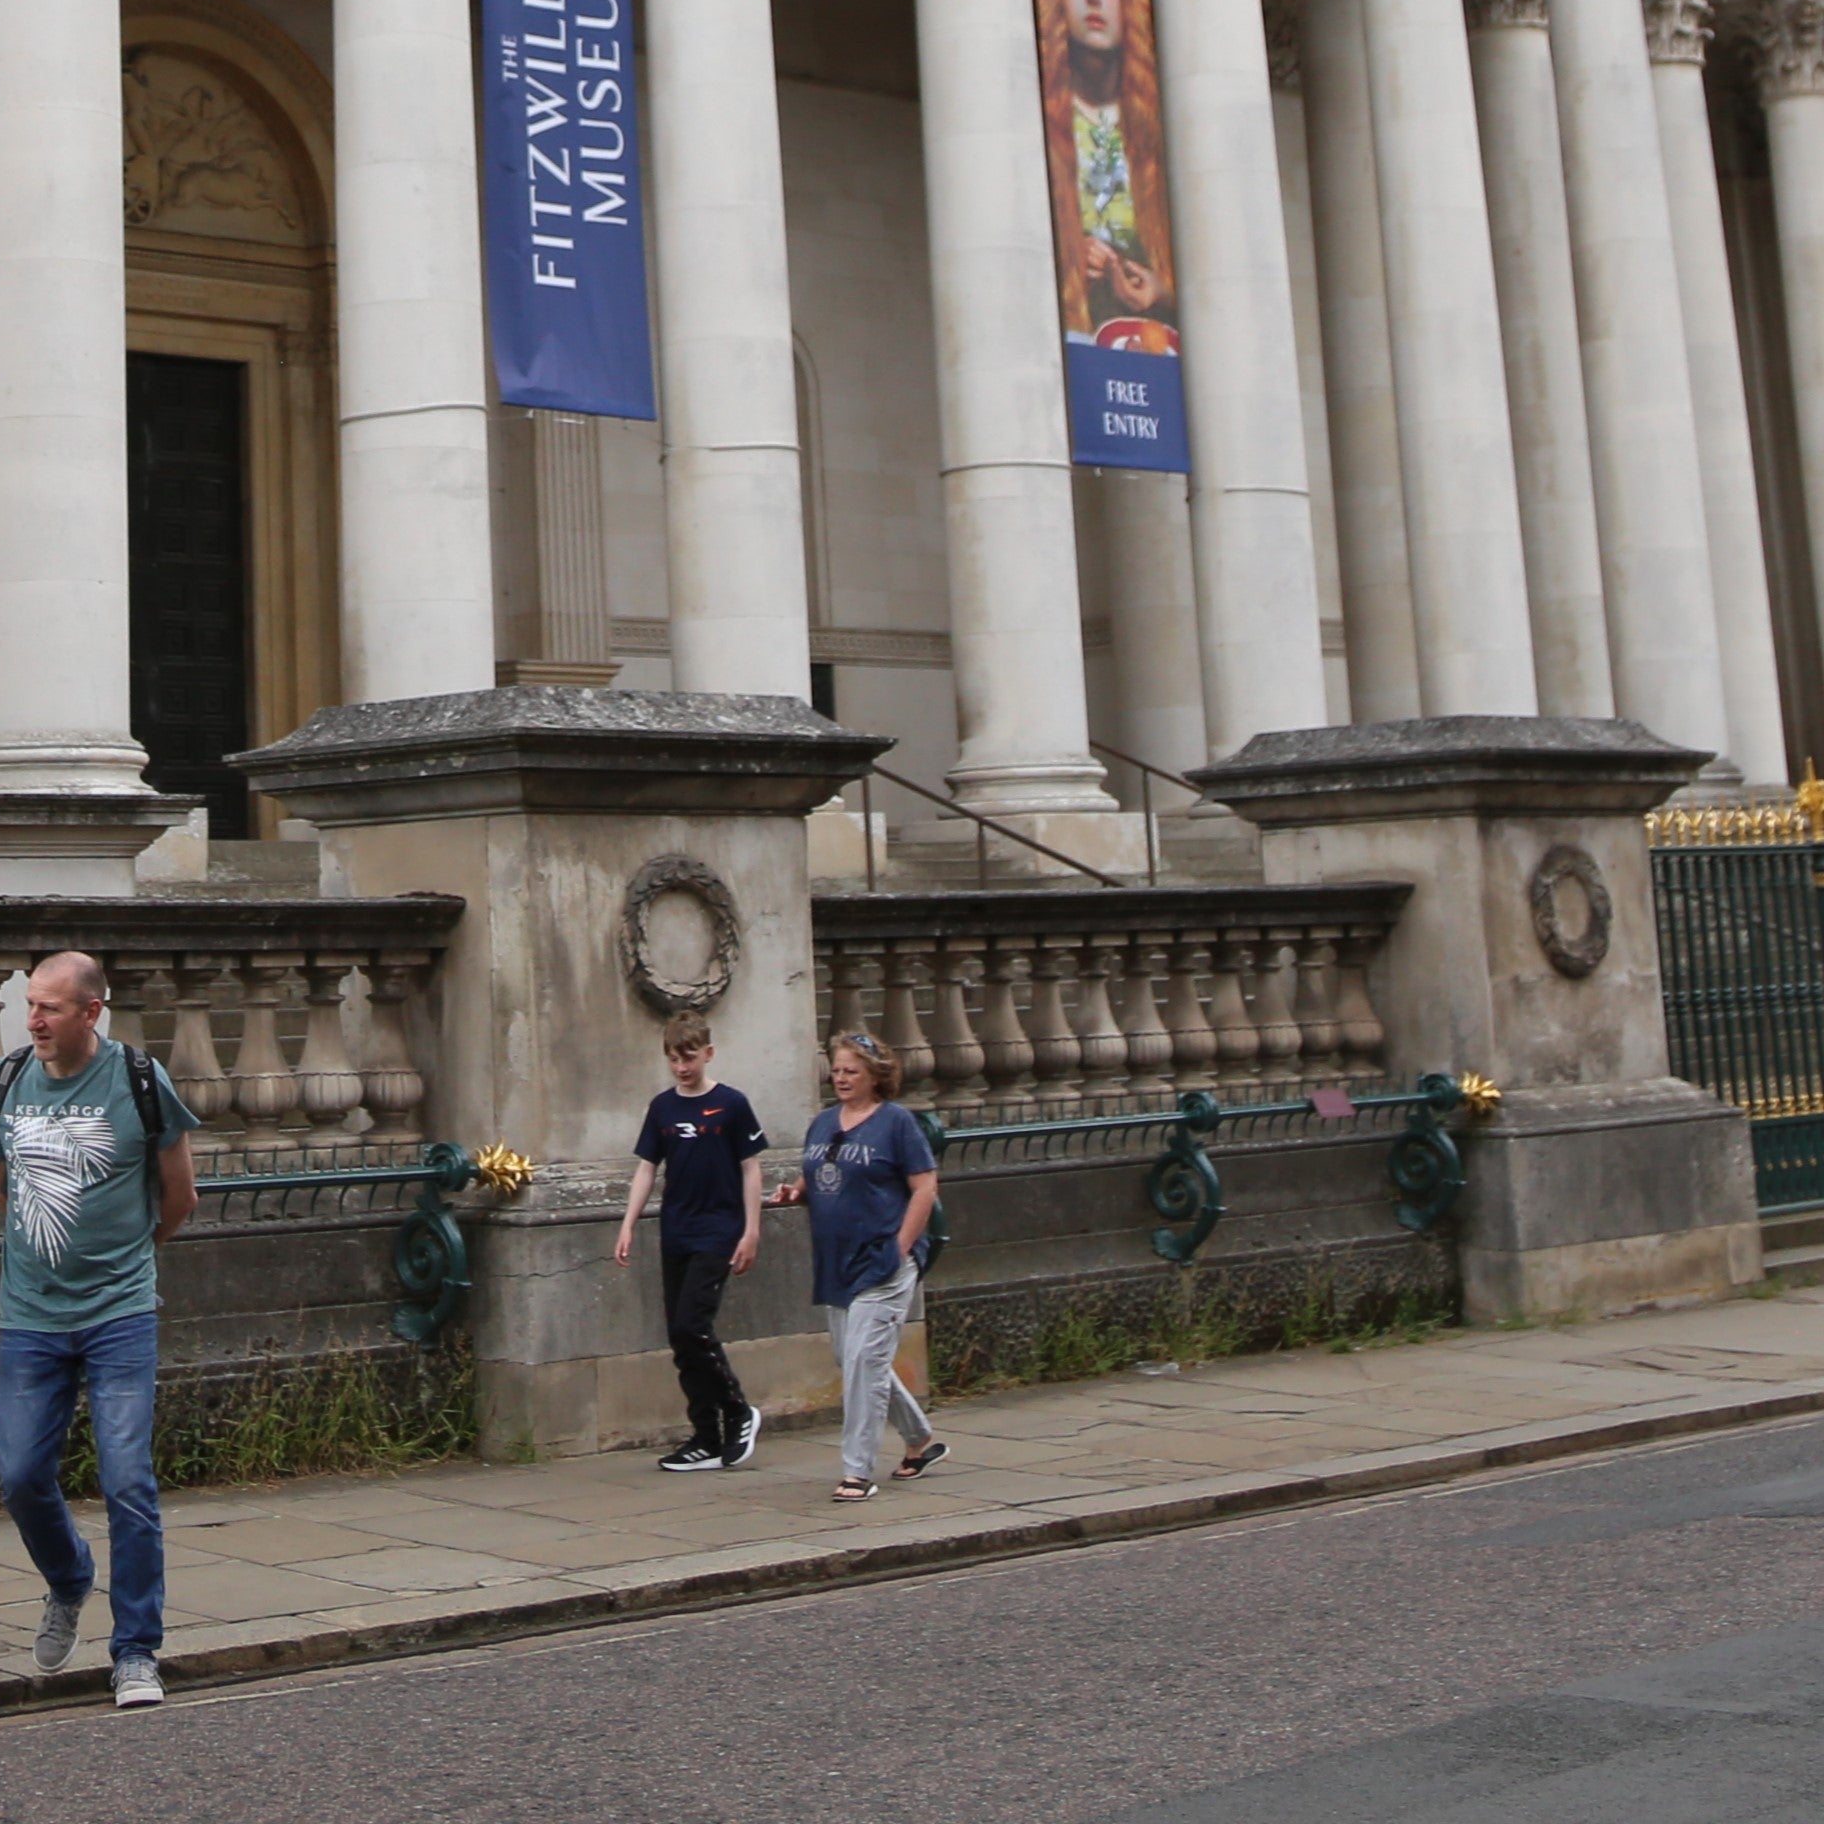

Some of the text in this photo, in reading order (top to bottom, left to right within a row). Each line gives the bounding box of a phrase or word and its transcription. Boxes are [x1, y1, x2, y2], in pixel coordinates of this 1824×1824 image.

[501, 35, 518, 82] THE
[1106, 379, 1150, 407] FREE
[1102, 411, 1159, 439] ENTRY
[15, 1104, 105, 1116] KEY LARGO
